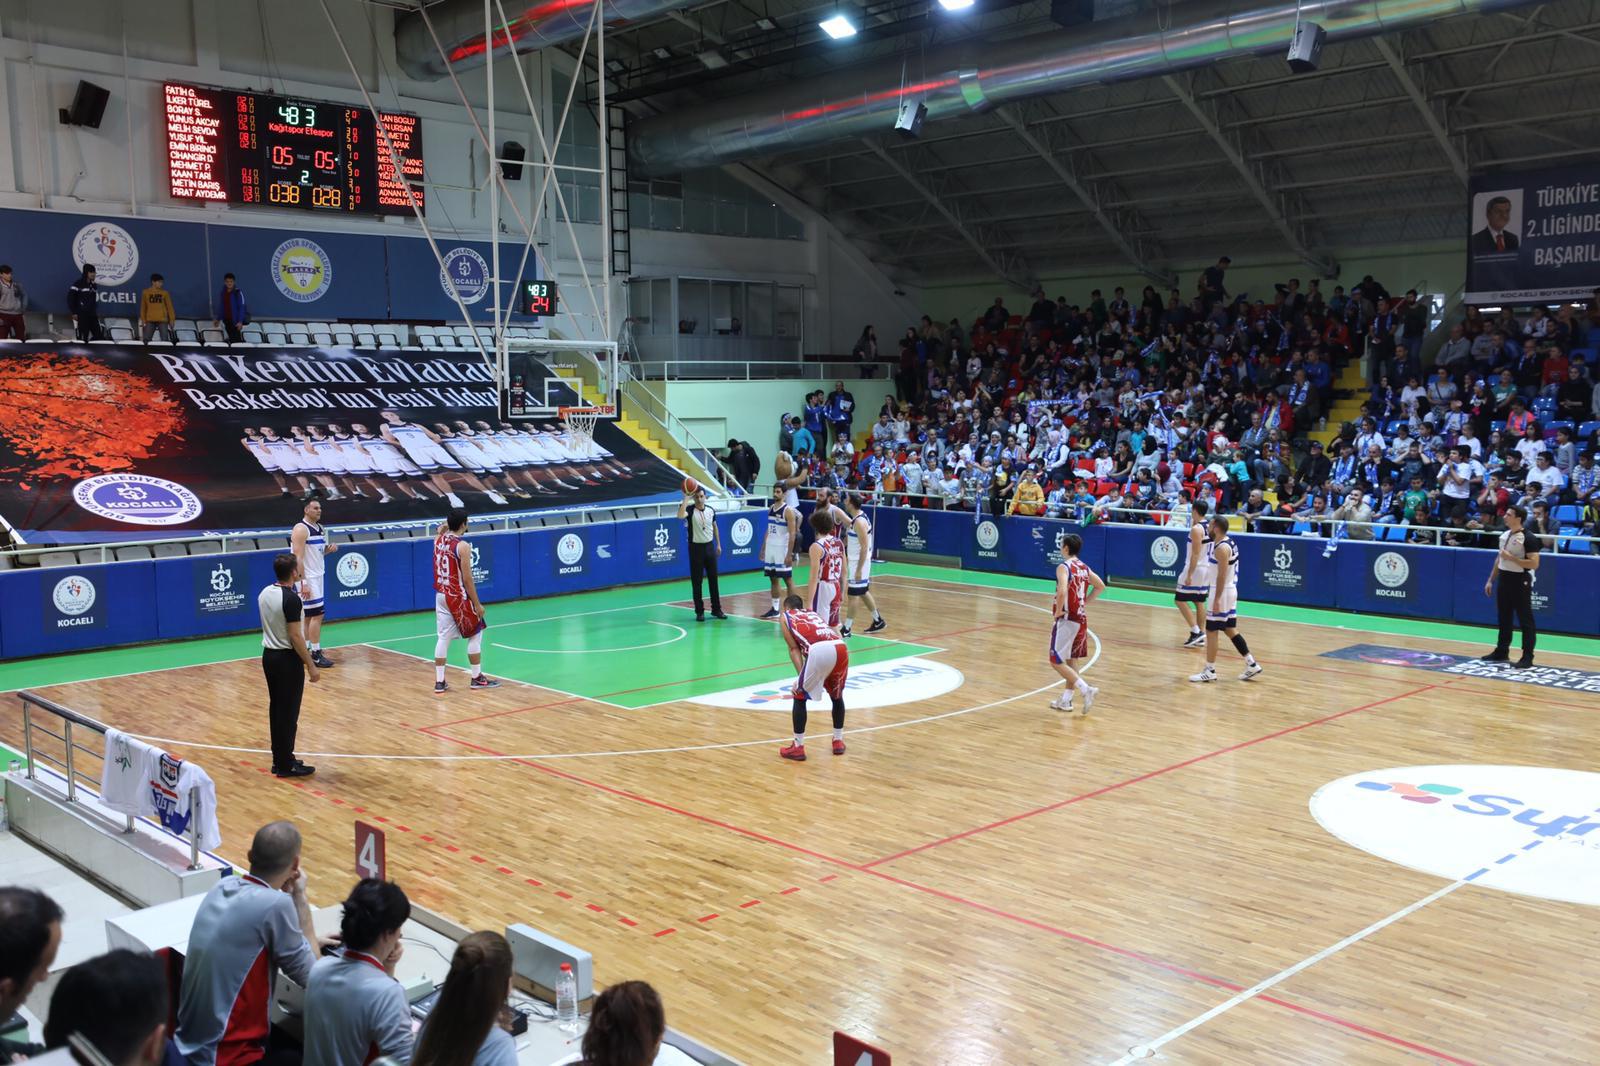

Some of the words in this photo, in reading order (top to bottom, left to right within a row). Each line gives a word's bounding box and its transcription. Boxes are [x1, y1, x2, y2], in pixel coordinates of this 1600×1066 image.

[192, 126, 218, 136] SEVDA
[171, 160, 204, 171] MEHMET
[273, 146, 294, 166] 05
[314, 150, 335, 170] 05
[301, 170, 310, 183] 2
[270, 183, 300, 204] 038
[312, 187, 341, 207] 028
[1536, 182, 1600, 208] TÜRKİYE
[1534, 244, 1600, 268] BAŞARIL
[531, 295, 549, 313] 24
[149, 353, 231, 383] Bu
[216, 354, 366, 384] Kentin
[365, 387, 424, 408] Yeni
[359, 832, 379, 879] 4
